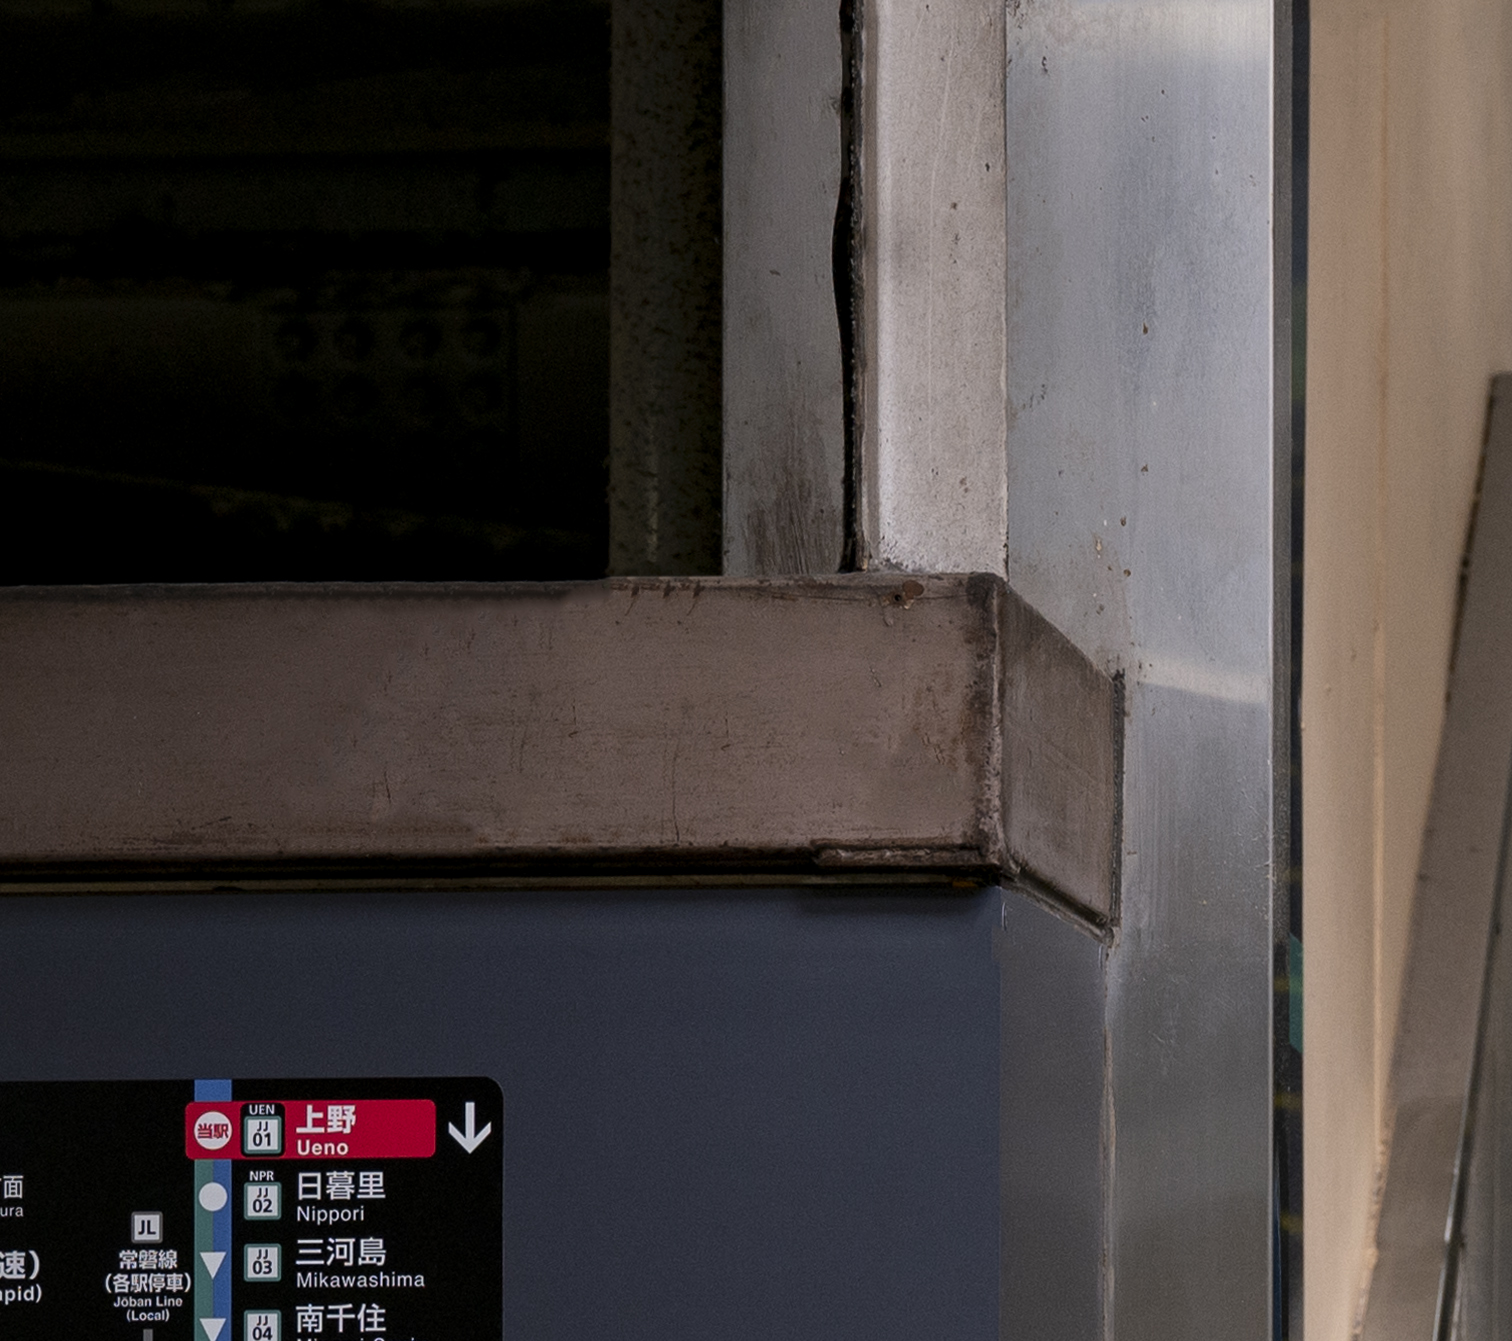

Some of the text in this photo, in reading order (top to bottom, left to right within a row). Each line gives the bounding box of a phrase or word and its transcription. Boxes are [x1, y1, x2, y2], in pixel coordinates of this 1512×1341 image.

[249, 1104, 274, 1115] UEN
[296, 1105, 356, 1134] 上野
[198, 1123, 228, 1139] 当駅
[253, 1131, 271, 1147] 01
[298, 1140, 348, 1155] Ueno
[250, 1171, 274, 1181] NPR
[299, 1171, 385, 1200] 日暮里
[253, 1199, 272, 1213] 02
[297, 1206, 364, 1225] Nippori
[138, 1220, 156, 1235] JL
[296, 1237, 386, 1266] 三河島
[119, 1249, 177, 1270] 常磐線
[253, 1259, 272, 1274] 03
[297, 1272, 424, 1288] Mikawashima
[114, 1296, 182, 1307] Jōban Line
[127, 1309, 169, 1322] (Local)
[296, 1303, 386, 1333] 南千住
[253, 1327, 272, 1341] 04
